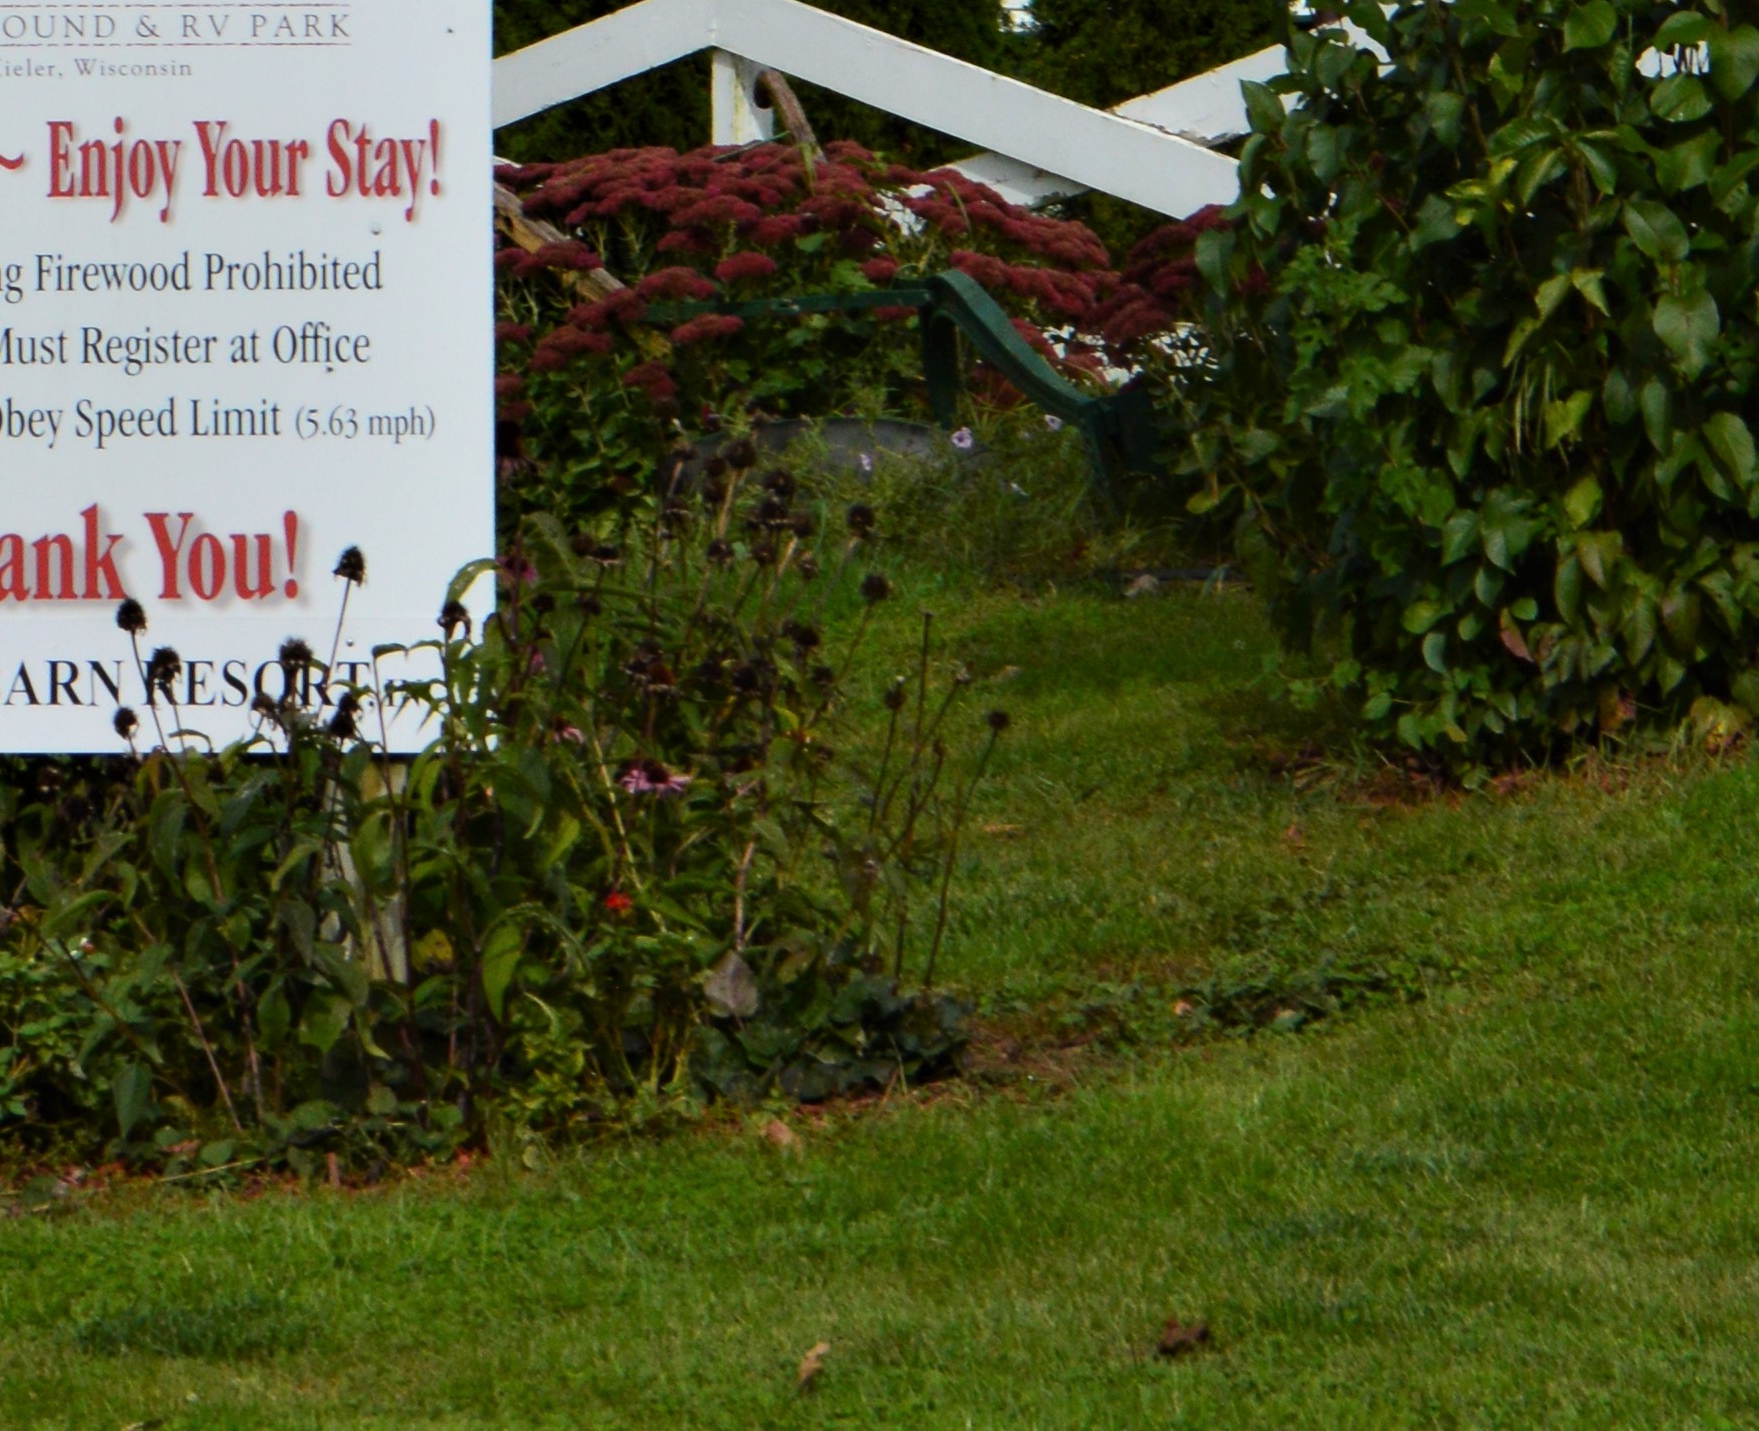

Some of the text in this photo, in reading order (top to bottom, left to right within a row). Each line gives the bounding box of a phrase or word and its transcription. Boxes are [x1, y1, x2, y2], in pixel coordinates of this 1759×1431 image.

[135, 14, 160, 38] &
[181, 14, 230, 38] RV
[251, 14, 350, 38] PARK
[73, 58, 192, 77] Wisconsin
[46, 116, 182, 223] Enjoy
[193, 119, 310, 199] Your
[326, 118, 441, 222] Stay!
[35, 250, 192, 292] Firewood
[204, 250, 384, 292] Prohibited
[80, 326, 218, 376] Register
[230, 331, 260, 364] at
[272, 321, 371, 364] Office
[74, 396, 178, 450] Speed
[190, 398, 281, 438] Limit
[294, 407, 359, 440] (5.63
[368, 405, 436, 444] mph)
[144, 510, 299, 602] You!
